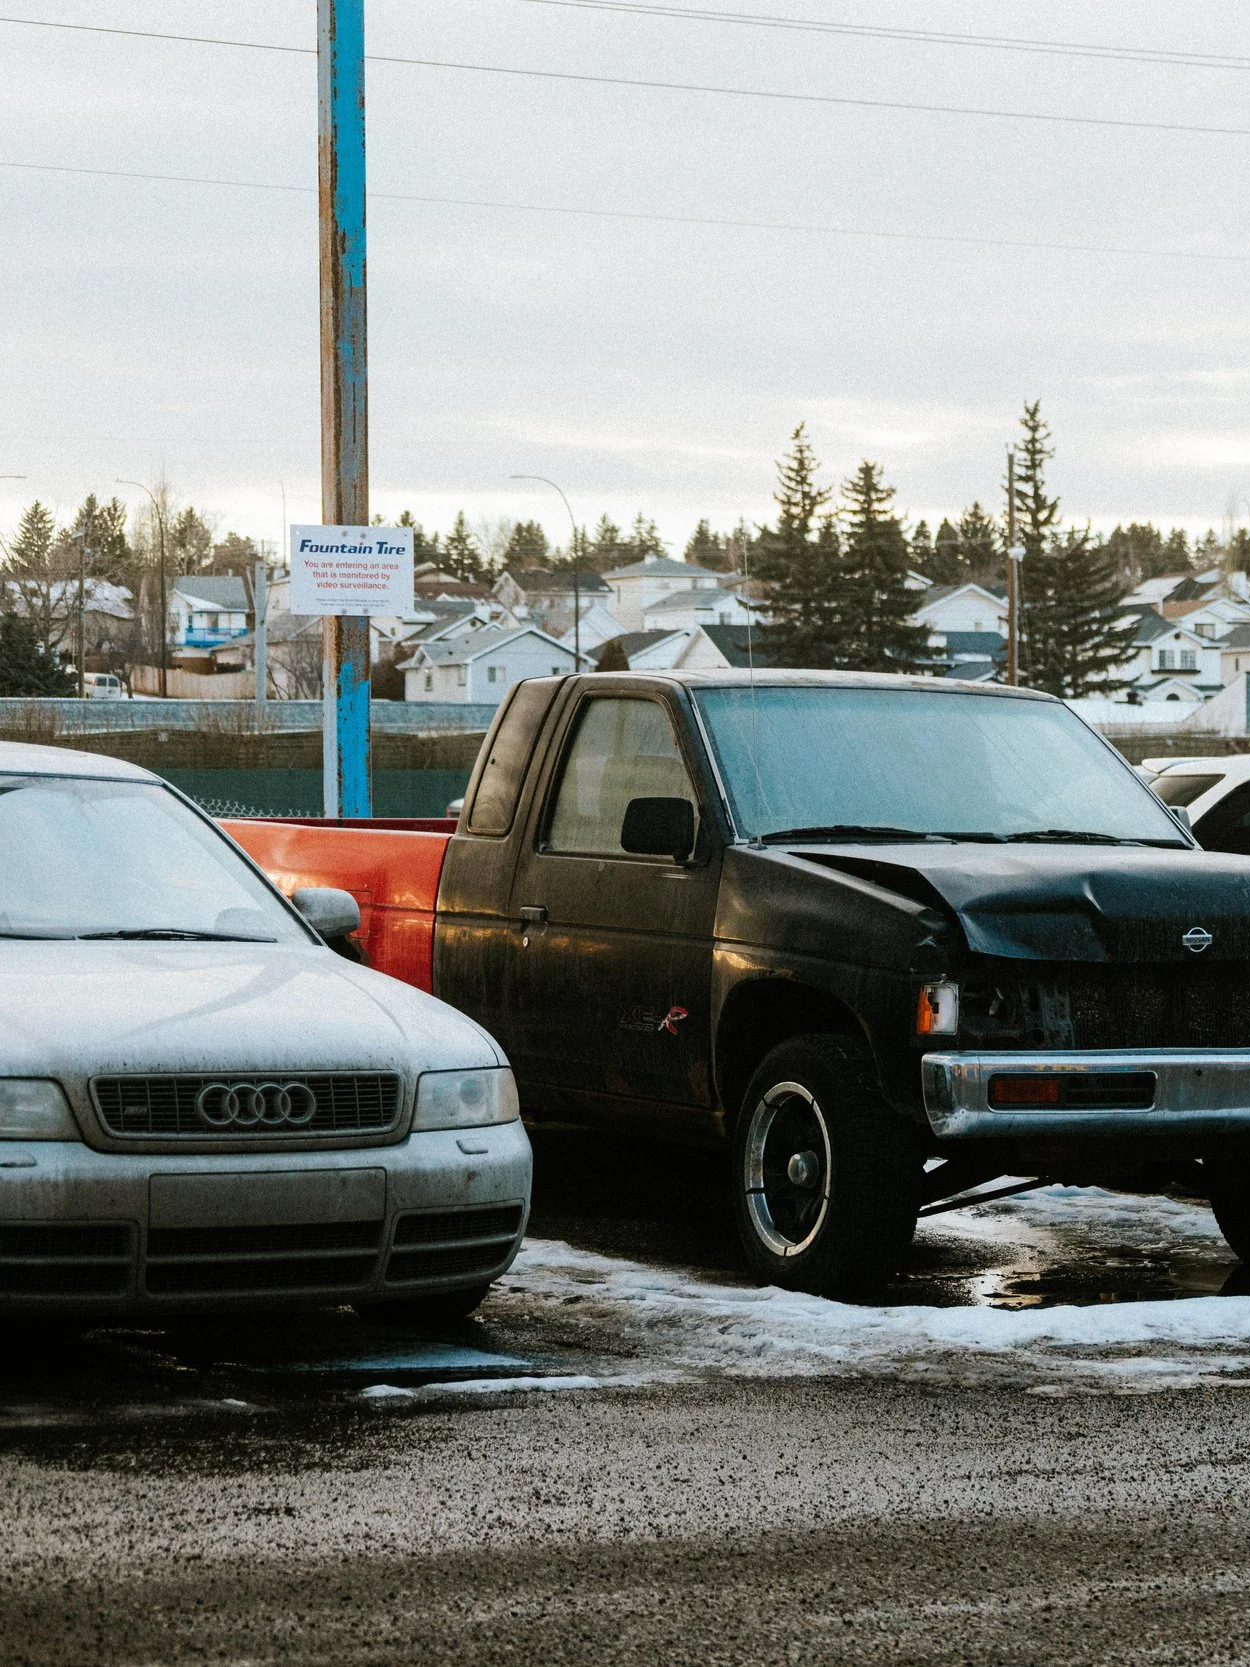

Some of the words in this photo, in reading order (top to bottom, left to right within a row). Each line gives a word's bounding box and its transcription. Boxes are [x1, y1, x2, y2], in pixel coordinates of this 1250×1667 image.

[299, 539, 373, 554] Fountain
[376, 541, 406, 555] Tire
[304, 560, 319, 568] You
[335, 561, 368, 570] entering
[312, 570, 328, 578] that
[339, 571, 379, 579] monitored
[381, 571, 391, 580] by
[316, 580, 338, 588] video
[339, 581, 389, 590] surveillance.
